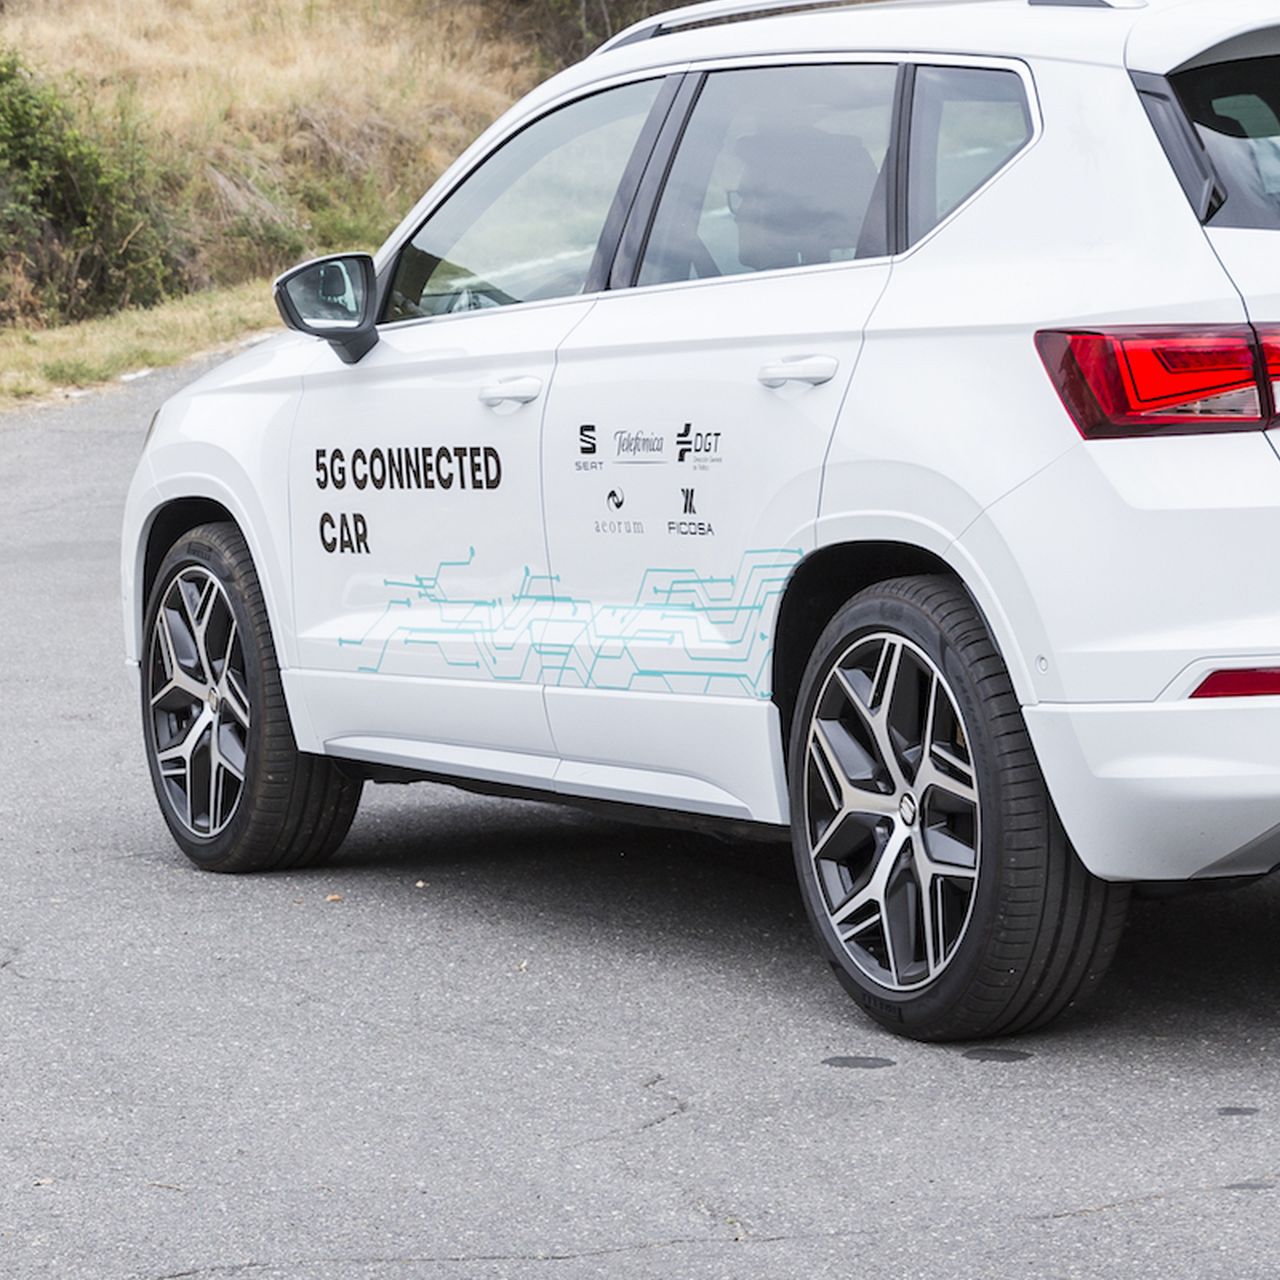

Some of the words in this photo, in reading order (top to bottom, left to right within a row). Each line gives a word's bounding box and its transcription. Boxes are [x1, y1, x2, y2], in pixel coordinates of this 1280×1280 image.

[693, 432, 721, 453] DGT
[315, 448, 346, 490] 5G
[352, 446, 502, 490] CONNECTED
[575, 461, 604, 471] SEAT
[319, 512, 370, 554] CAR
[667, 521, 715, 536] FICOSA
